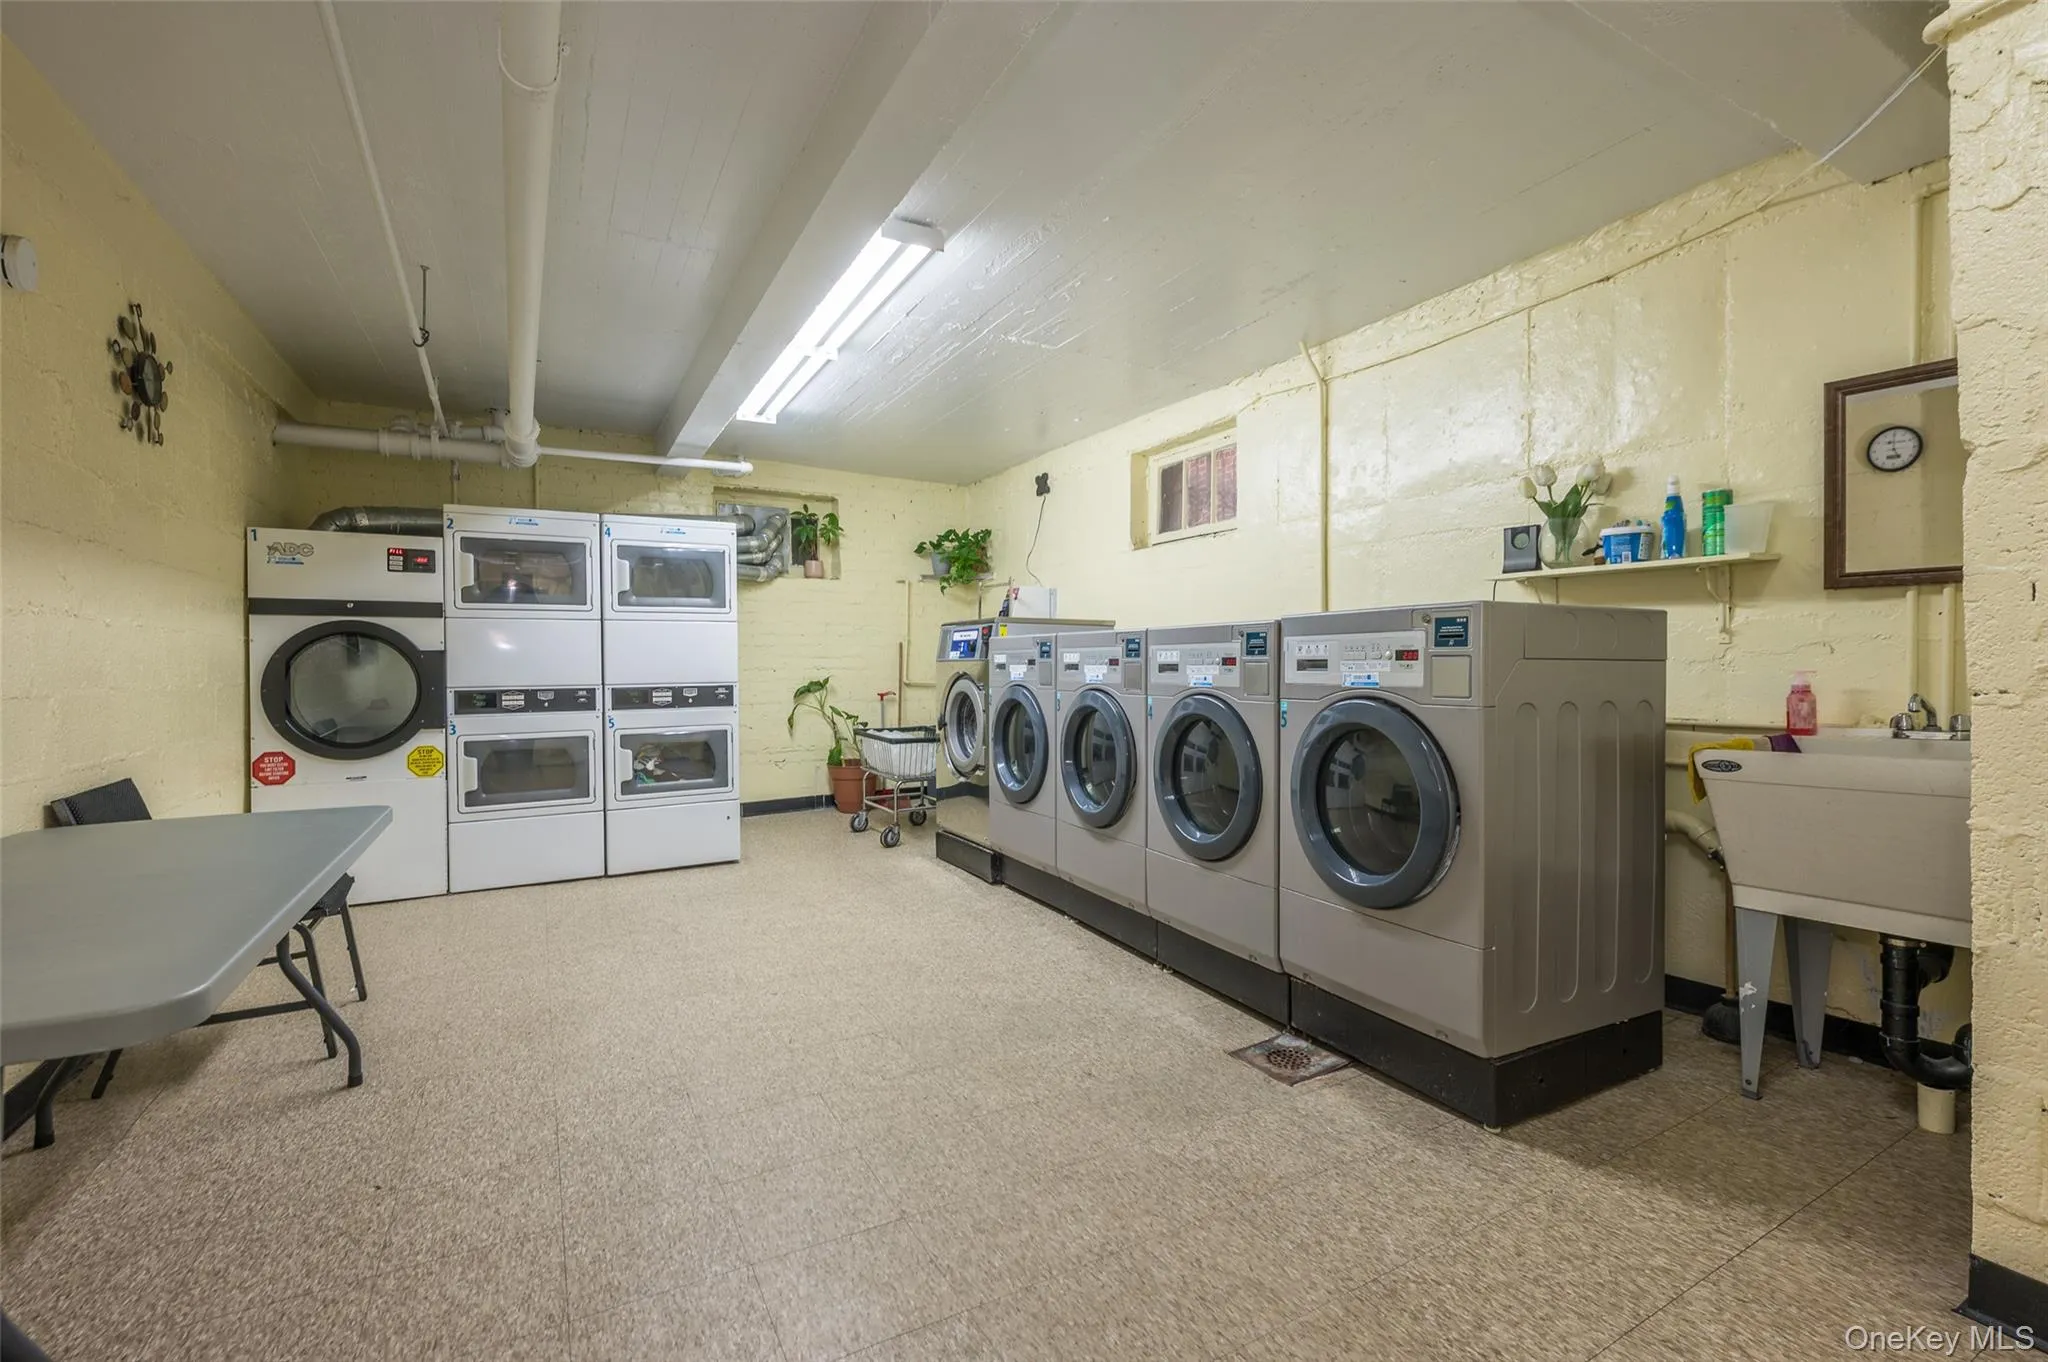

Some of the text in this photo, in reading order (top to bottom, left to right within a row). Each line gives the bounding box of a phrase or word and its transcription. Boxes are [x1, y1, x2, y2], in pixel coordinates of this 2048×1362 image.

[446, 518, 454, 529] 2
[250, 528, 257, 541] 1
[604, 527, 611, 538] 4
[608, 717, 615, 729] 5
[1280, 710, 1288, 728] 5
[449, 724, 457, 735] 3
